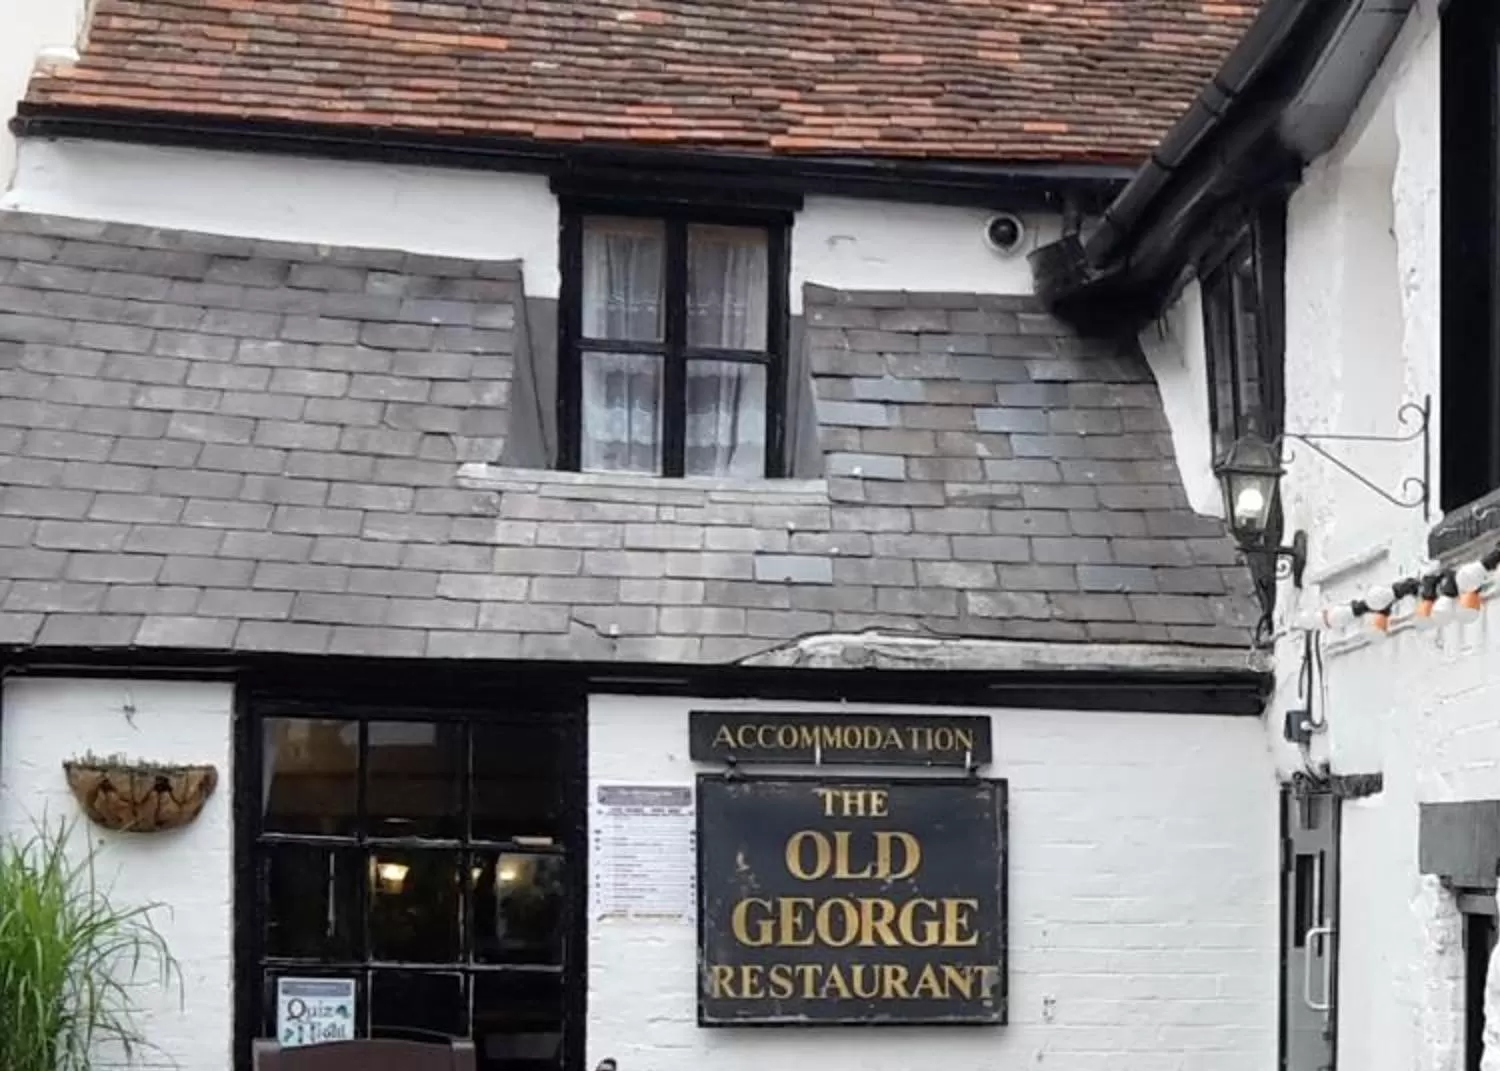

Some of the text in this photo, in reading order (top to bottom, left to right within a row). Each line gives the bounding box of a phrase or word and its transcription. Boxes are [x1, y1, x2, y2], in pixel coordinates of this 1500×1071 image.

[711, 723, 974, 751] ACCOMMODATION
[820, 788, 889, 816] THE
[785, 830, 921, 880] OLD
[732, 896, 979, 947] GEORGE
[710, 964, 998, 999] RESTAURANT
